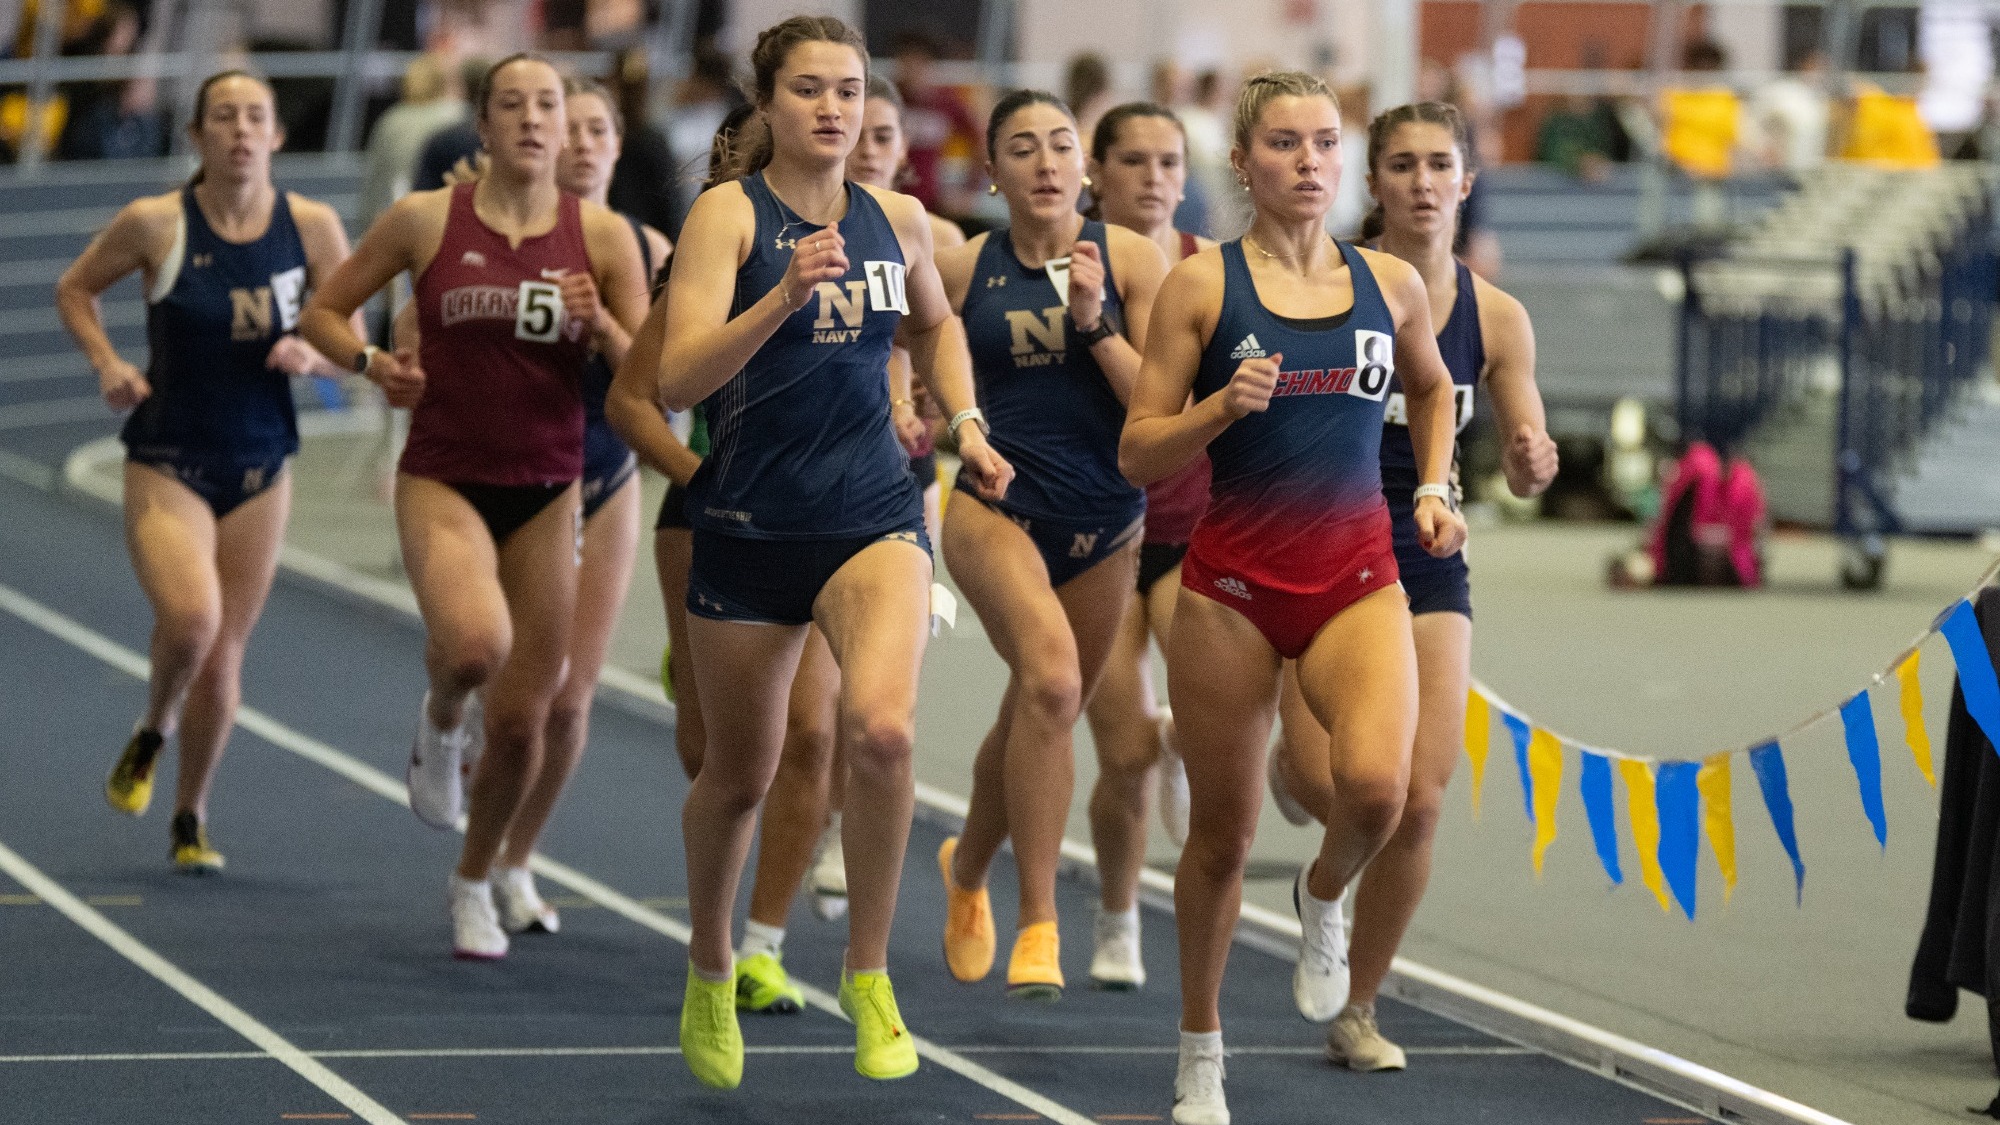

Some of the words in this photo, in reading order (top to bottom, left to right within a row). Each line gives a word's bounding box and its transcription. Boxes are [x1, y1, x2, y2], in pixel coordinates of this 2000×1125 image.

[230, 287, 271, 328] N
[523, 287, 554, 336] 5
[814, 281, 867, 328] N
[812, 329, 863, 343] NAVY
[1005, 307, 1069, 355] N
[1013, 353, 1066, 368] NAVY
[1230, 348, 1267, 360] adidas
[1358, 335, 1388, 396] 8
[1273, 366, 1357, 397] CHMO
[1069, 533, 1098, 558] N
[1213, 580, 1253, 601] adidas
